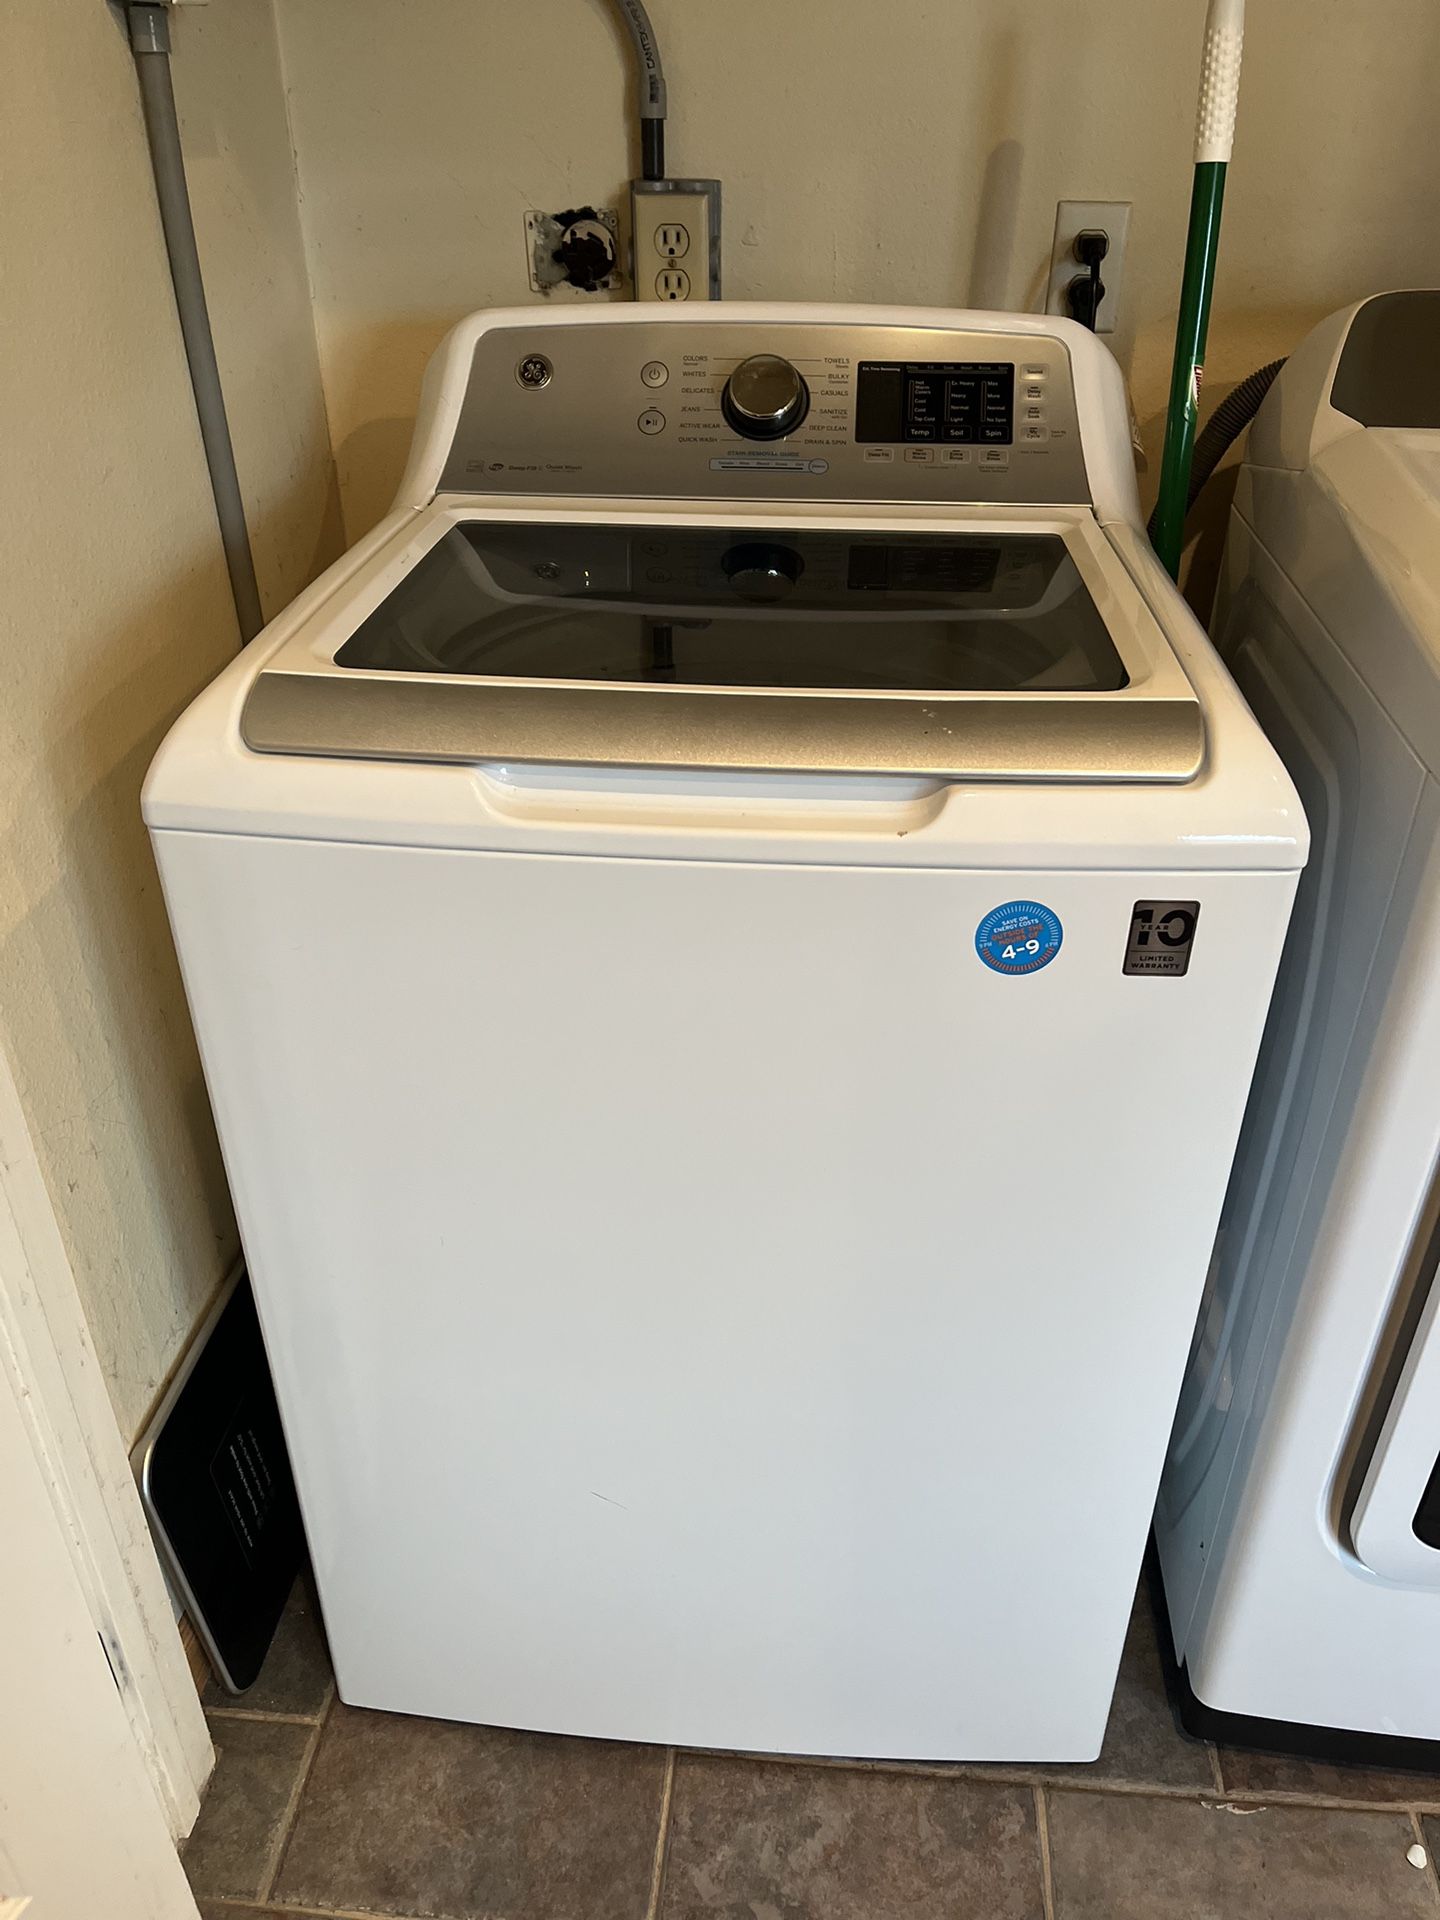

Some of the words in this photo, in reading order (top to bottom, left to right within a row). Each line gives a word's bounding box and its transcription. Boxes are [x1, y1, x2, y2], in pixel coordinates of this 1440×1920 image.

[639, 31, 655, 69] CANTEX
[911, 428, 930, 437] Temp
[993, 923, 1018, 933] ENERGY
[1019, 918, 1039, 927] COSTS
[1002, 918, 1018, 926] SAVE
[1133, 909, 1195, 946] 10
[1002, 939, 1040, 959] 4-9
